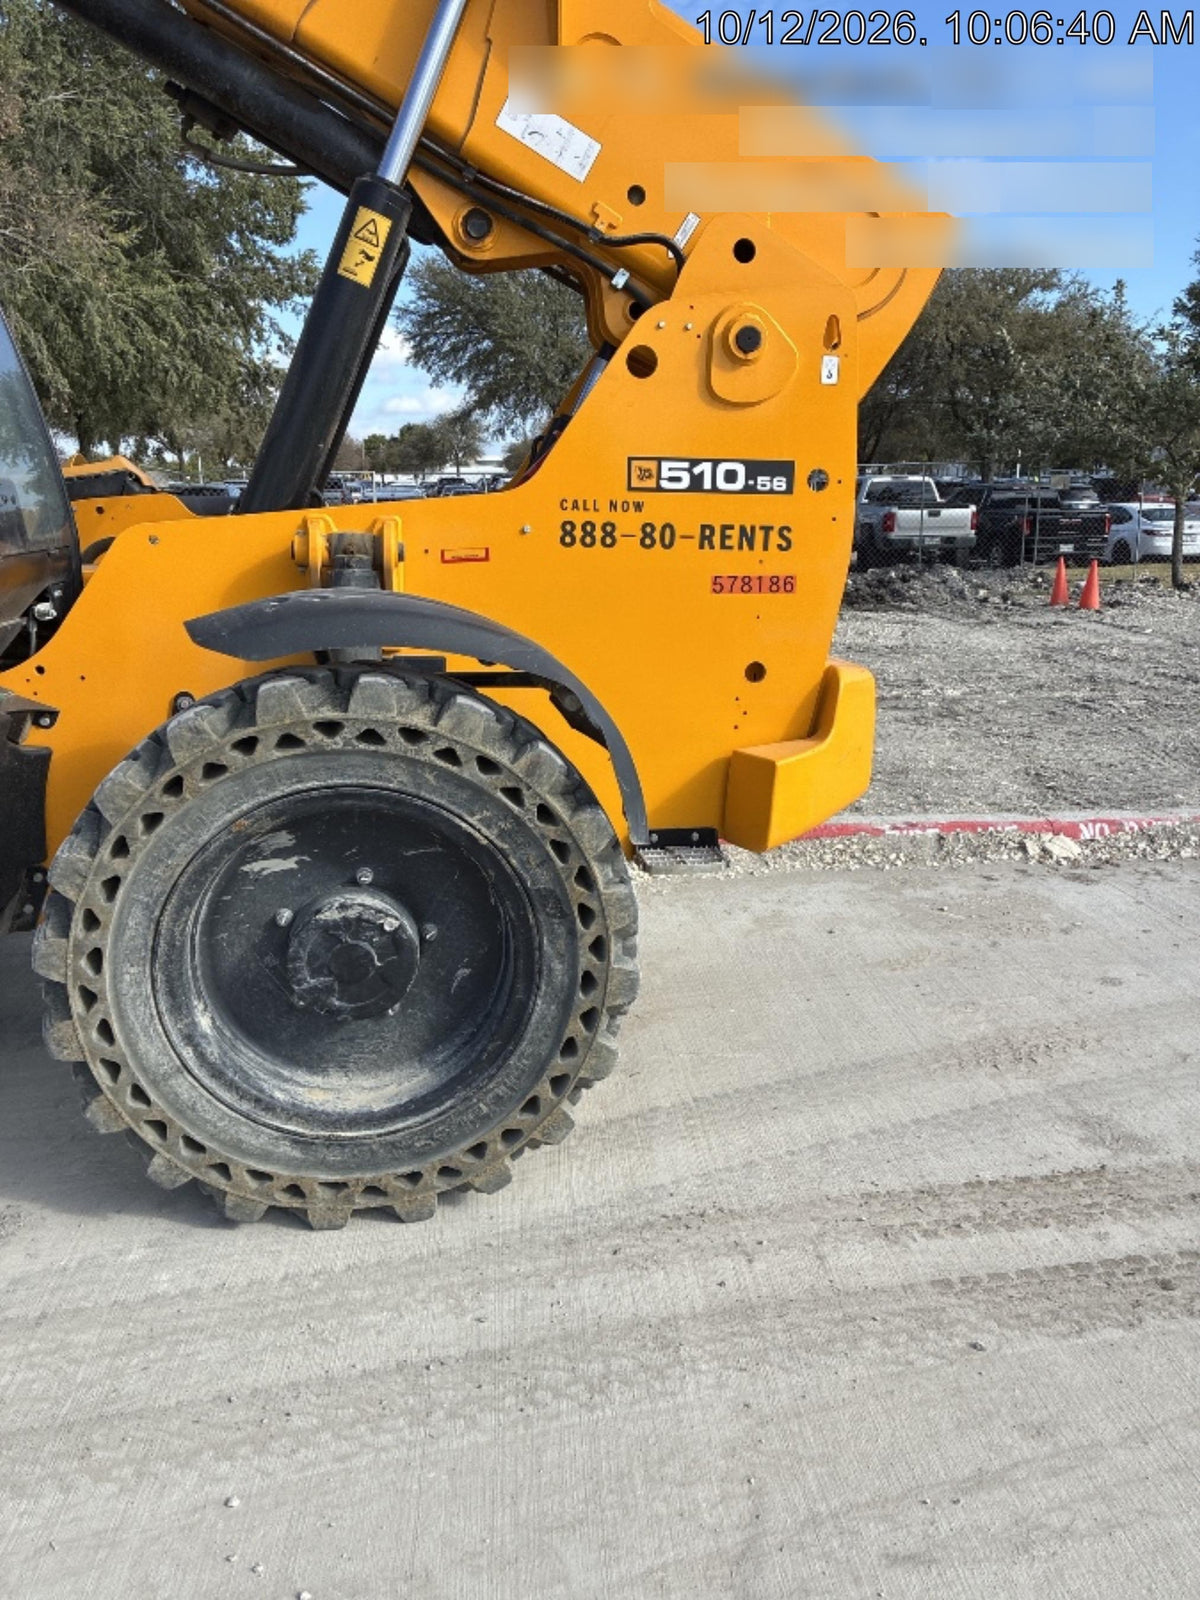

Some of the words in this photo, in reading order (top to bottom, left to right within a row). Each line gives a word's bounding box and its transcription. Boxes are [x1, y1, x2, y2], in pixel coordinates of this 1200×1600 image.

[560, 498, 600, 513] CALL
[609, 499, 645, 513] NOW
[559, 520, 792, 552] 888-80-RENTS
[712, 575, 794, 593] 578186
